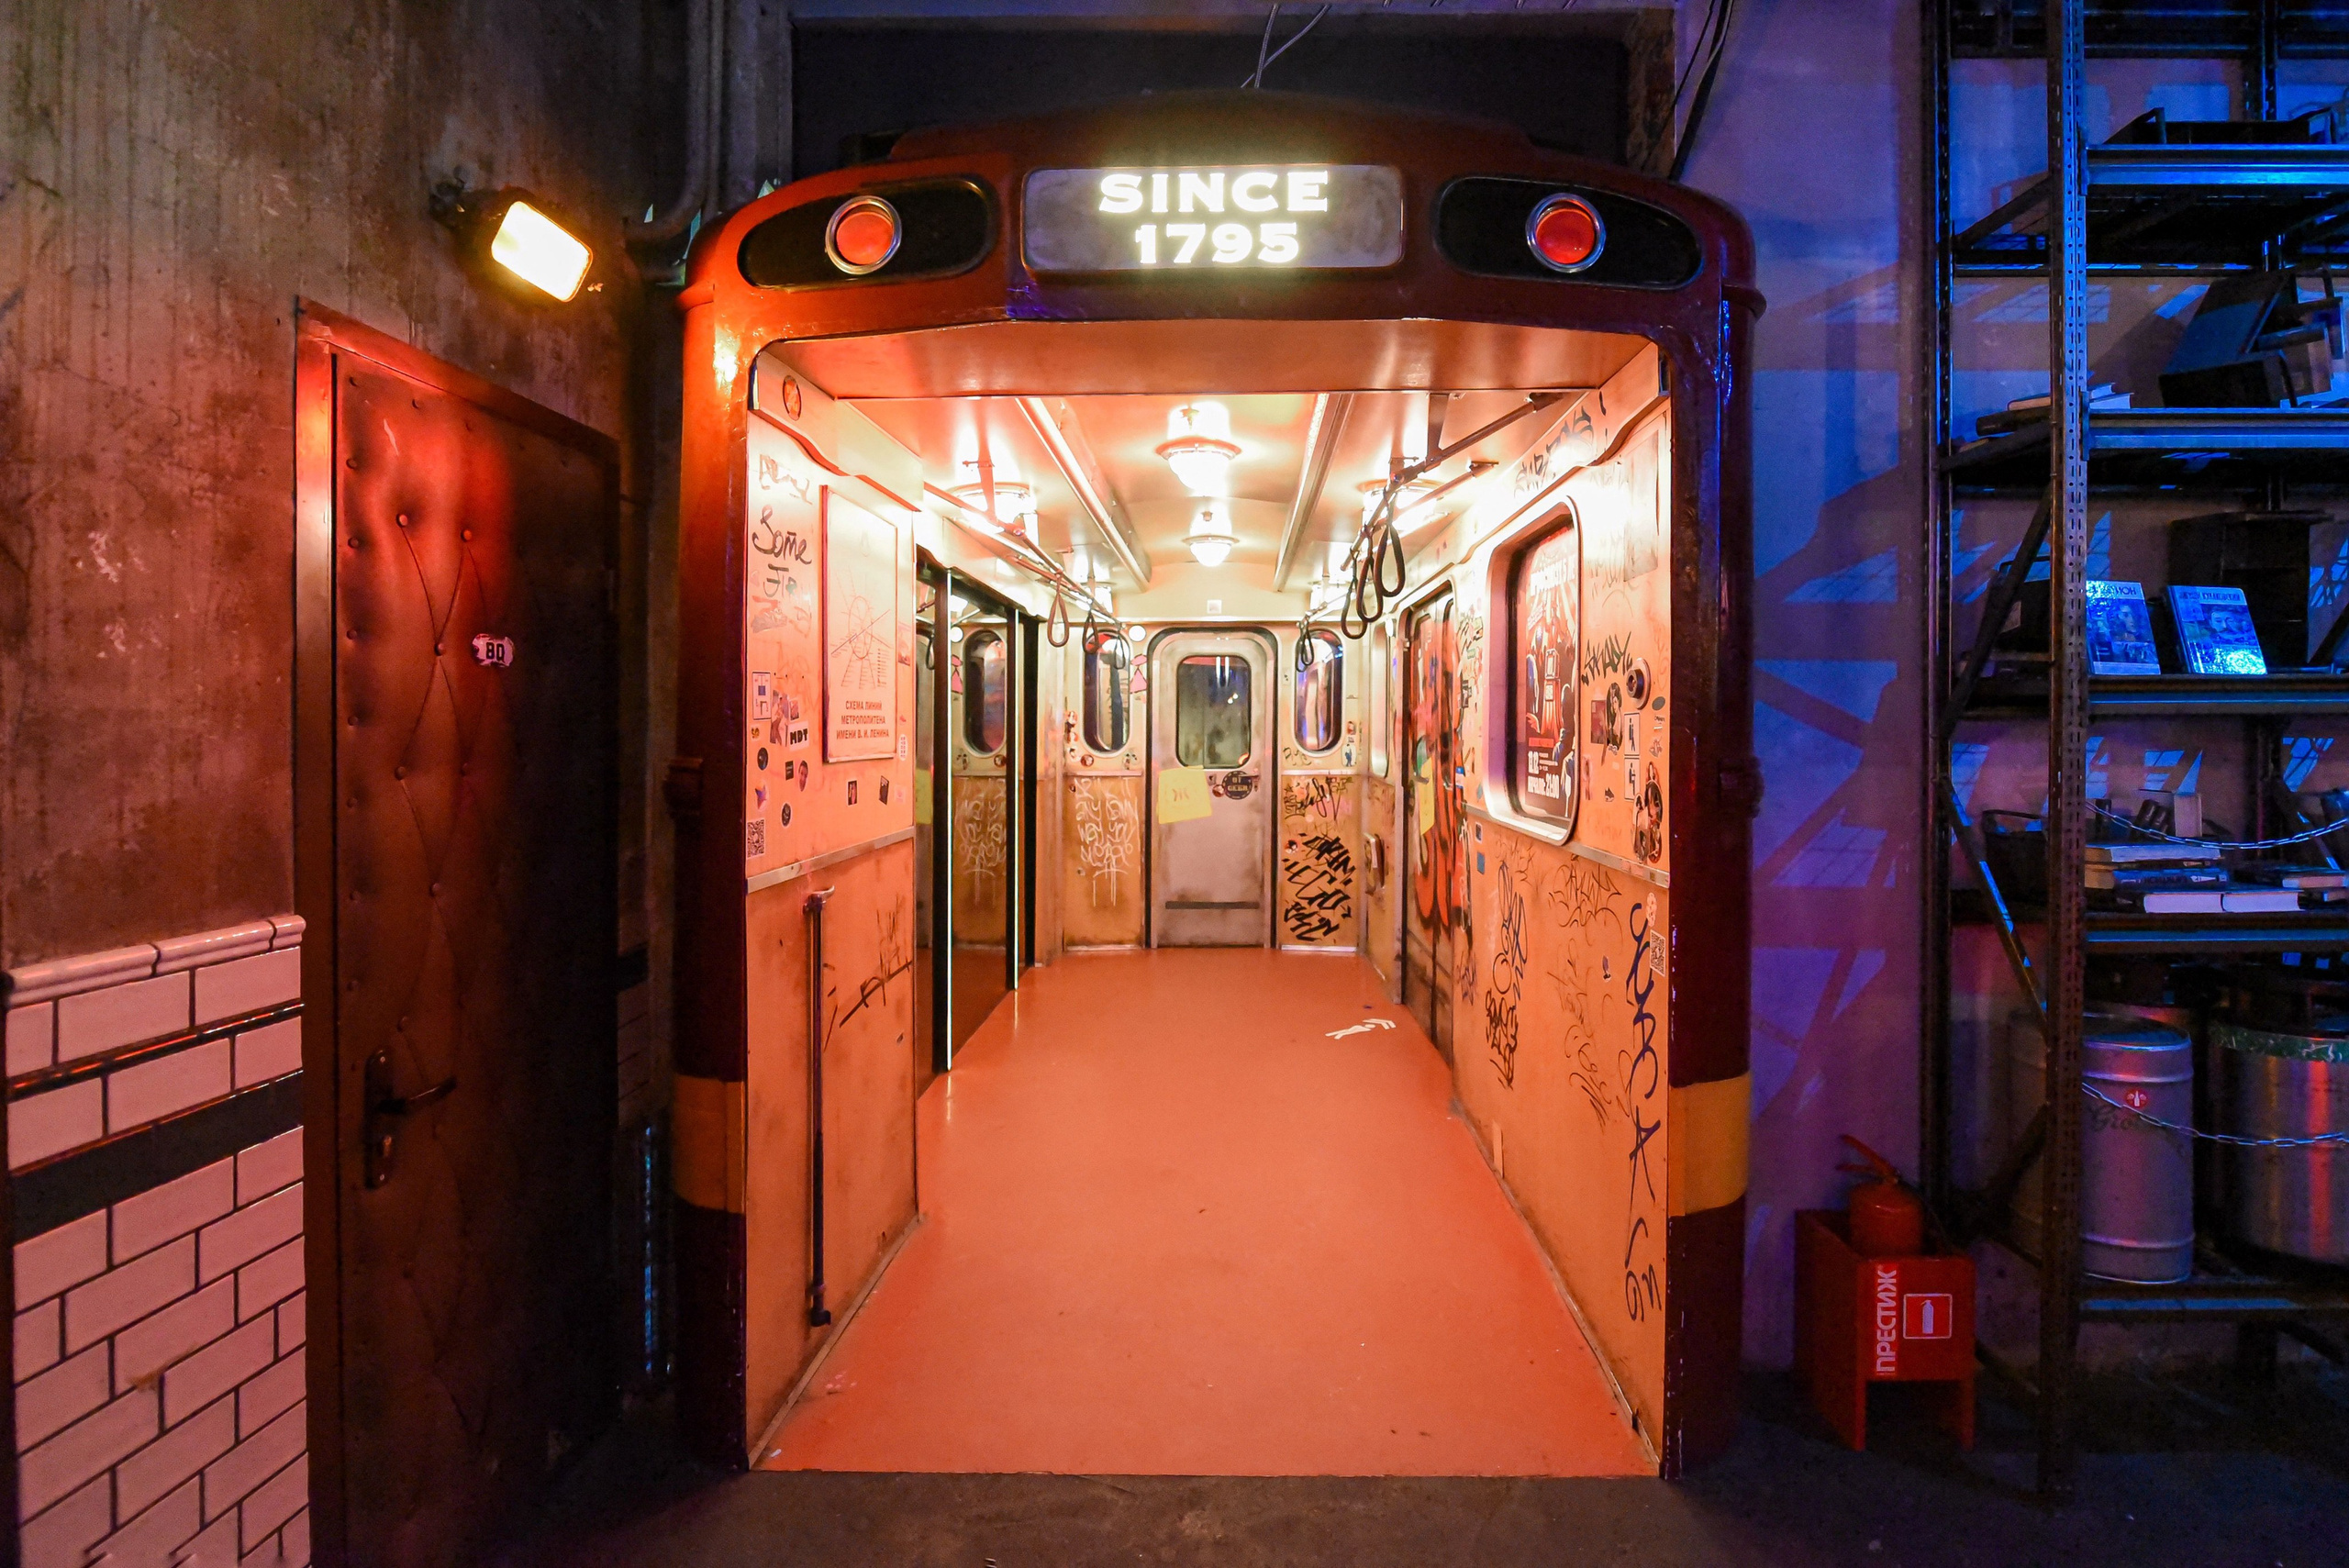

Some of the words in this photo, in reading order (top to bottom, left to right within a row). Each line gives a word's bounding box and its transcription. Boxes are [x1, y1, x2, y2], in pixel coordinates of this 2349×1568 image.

[1098, 170, 1329, 214] SINCE
[1134, 222, 1299, 264] 1795
[845, 700, 864, 710] СХЕМА
[865, 701, 882, 710] ЛИНИЙ
[841, 715, 886, 725] МЕТРОПОЛИТЕНА
[789, 728, 808, 745] MDT
[836, 729, 856, 740] ИМЕНИ
[870, 728, 889, 739] ЛЕНИНА
[1876, 1269, 1898, 1373] ПРЕСТИЖ
